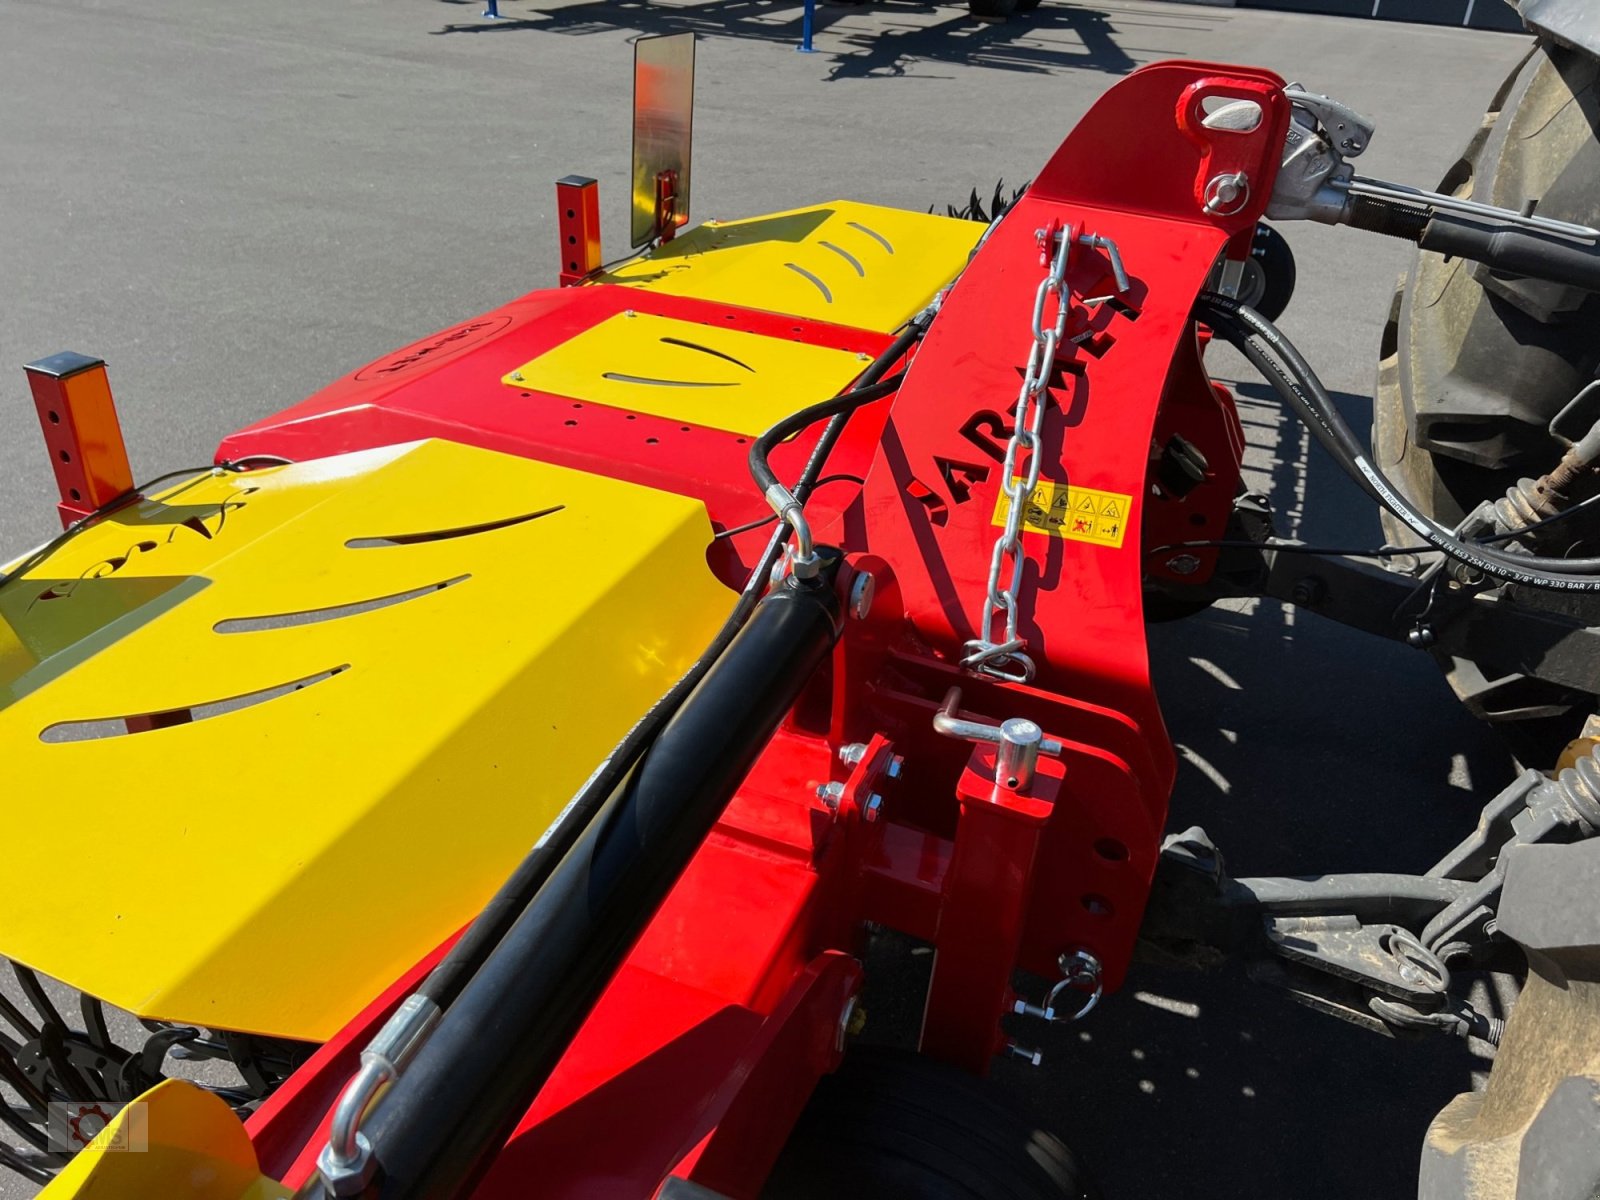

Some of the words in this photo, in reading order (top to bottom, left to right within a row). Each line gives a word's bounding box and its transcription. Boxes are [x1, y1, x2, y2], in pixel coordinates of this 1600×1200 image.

[1430, 533, 1444, 546] DIN
[1443, 541, 1455, 552] EN
[1483, 563, 1497, 573] DN
[1497, 568, 1507, 577] 10
[1533, 577, 1549, 586] WP
[1549, 580, 1565, 589] 330
[1567, 582, 1585, 590] BAR
